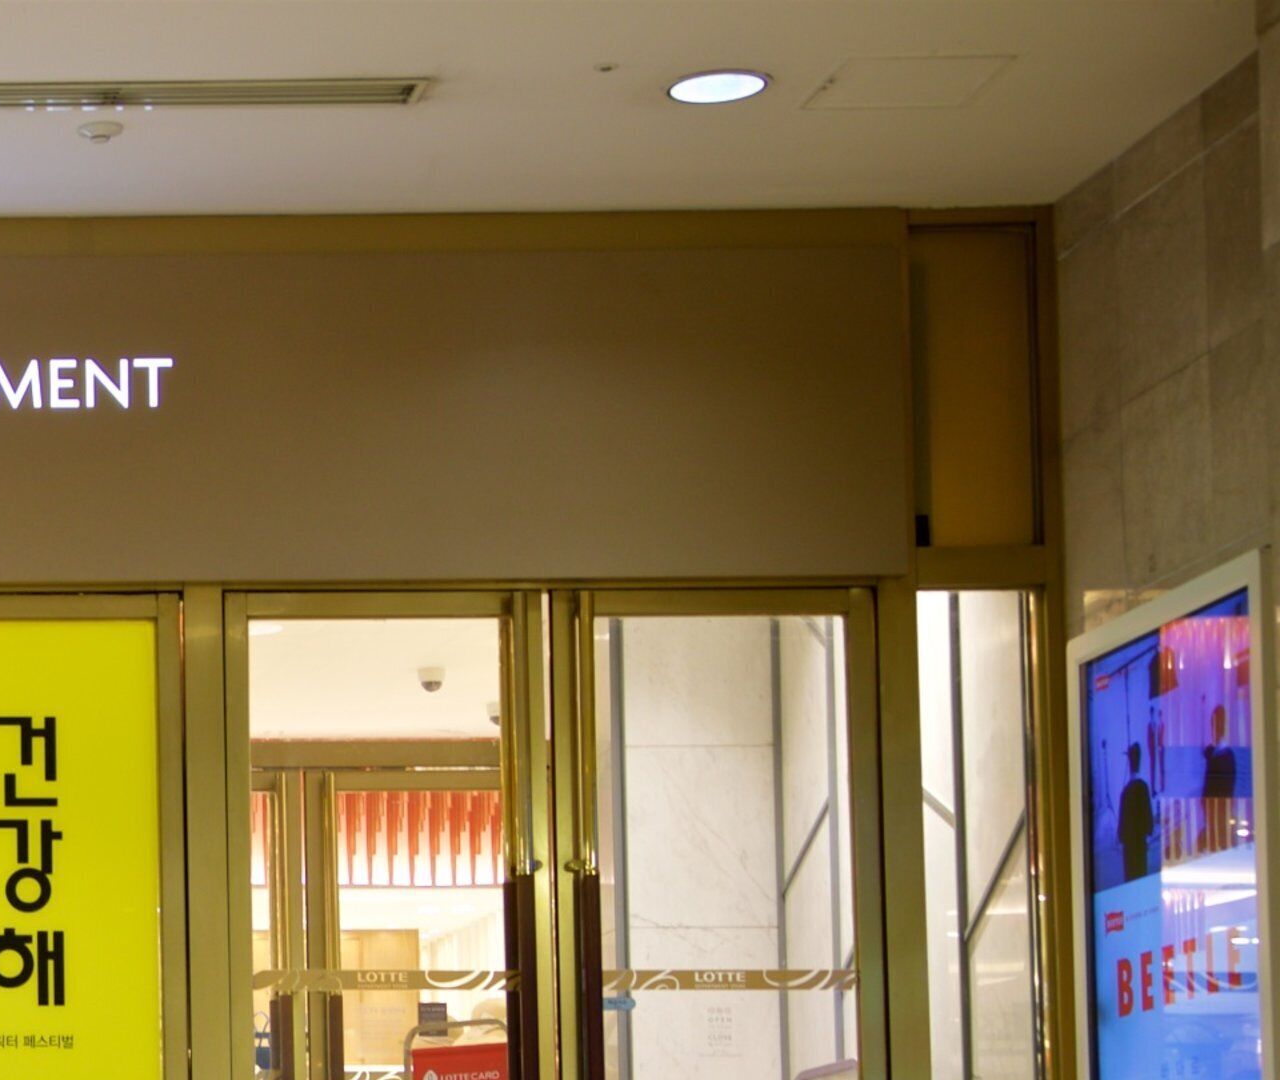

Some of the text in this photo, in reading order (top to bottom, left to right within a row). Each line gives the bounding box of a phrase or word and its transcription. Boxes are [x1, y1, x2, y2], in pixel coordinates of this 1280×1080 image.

[357, 971, 408, 983] LOTTE
[694, 971, 746, 983] LOTTE
[23, 1033, 75, 1050] 페스티벌
